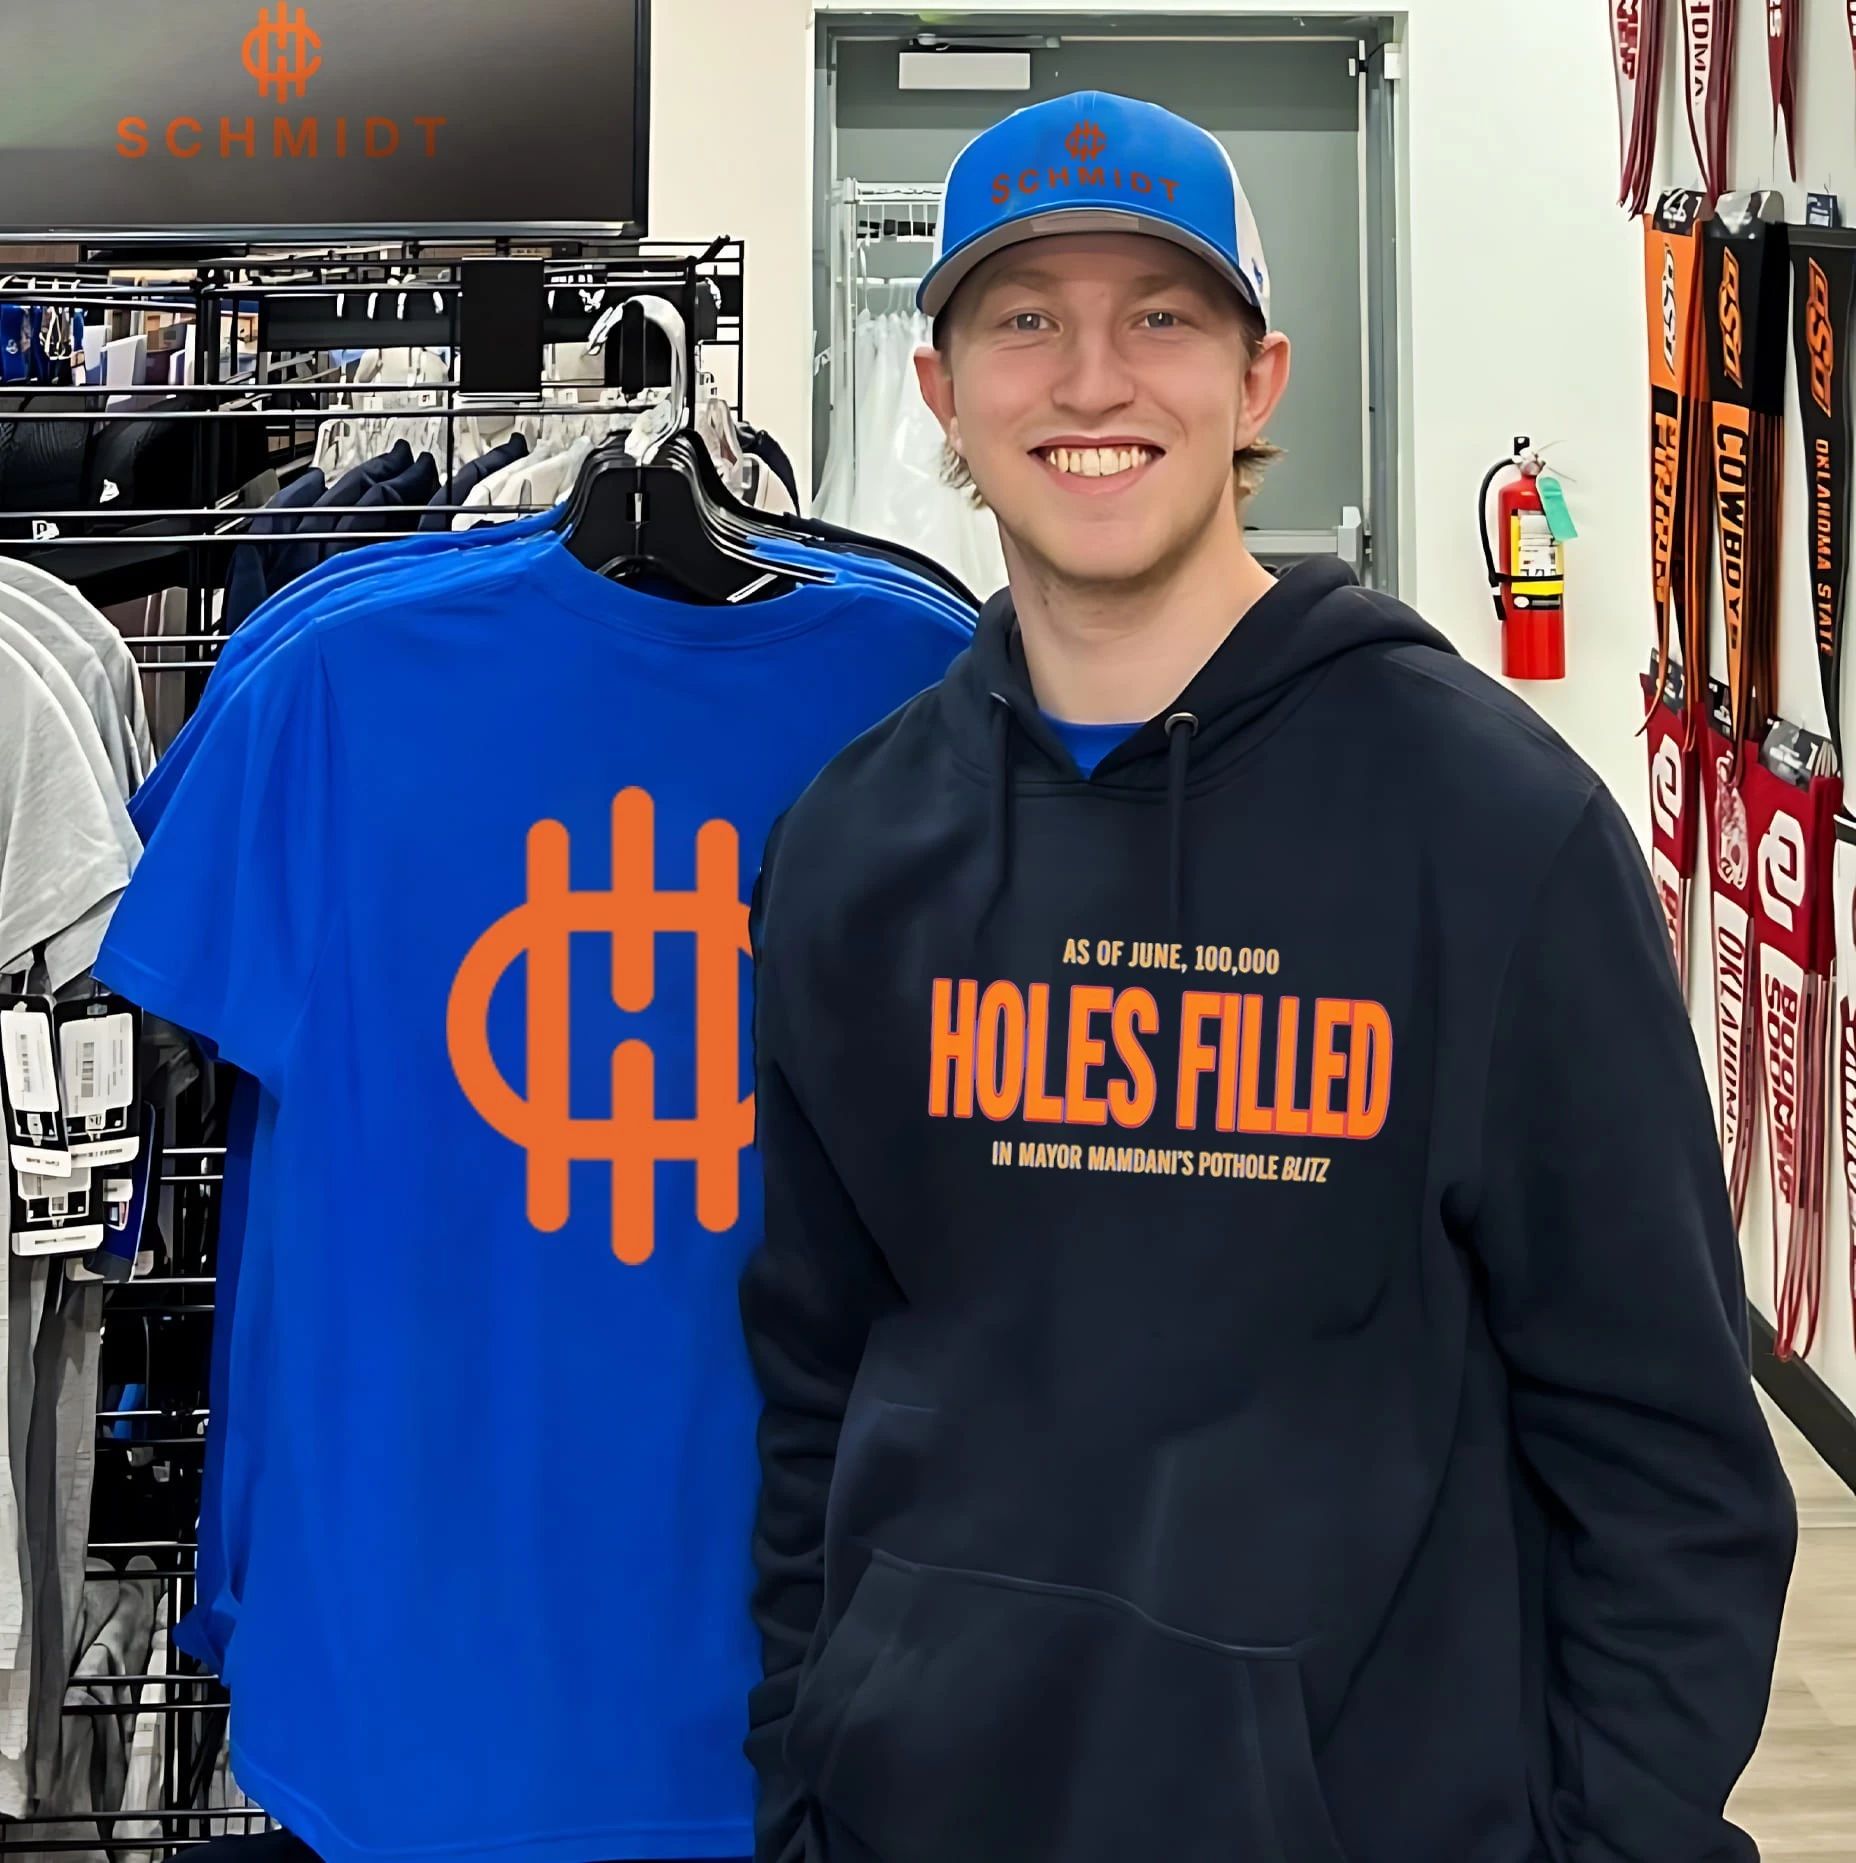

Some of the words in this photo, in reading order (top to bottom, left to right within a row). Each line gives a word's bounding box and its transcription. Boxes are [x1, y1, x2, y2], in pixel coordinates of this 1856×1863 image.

[115, 115, 447, 159] SCHMIDT
[992, 165, 1181, 205] SCHMIDT
[1815, 438, 1832, 570] OKLAHOMA
[1062, 938, 1091, 965] AS
[1097, 940, 1125, 966] OF
[1127, 941, 1187, 974] JUNE,
[1195, 945, 1280, 976] 100,000
[928, 977, 1160, 1129] HOLES
[1176, 990, 1394, 1140] FILLED
[992, 1141, 1012, 1167] IN
[1018, 1142, 1082, 1170] MAYOR
[1087, 1145, 1195, 1176] MAMDANI'S
[1198, 1151, 1279, 1181] POTHOLE
[1281, 1156, 1331, 1184] BLITZ
